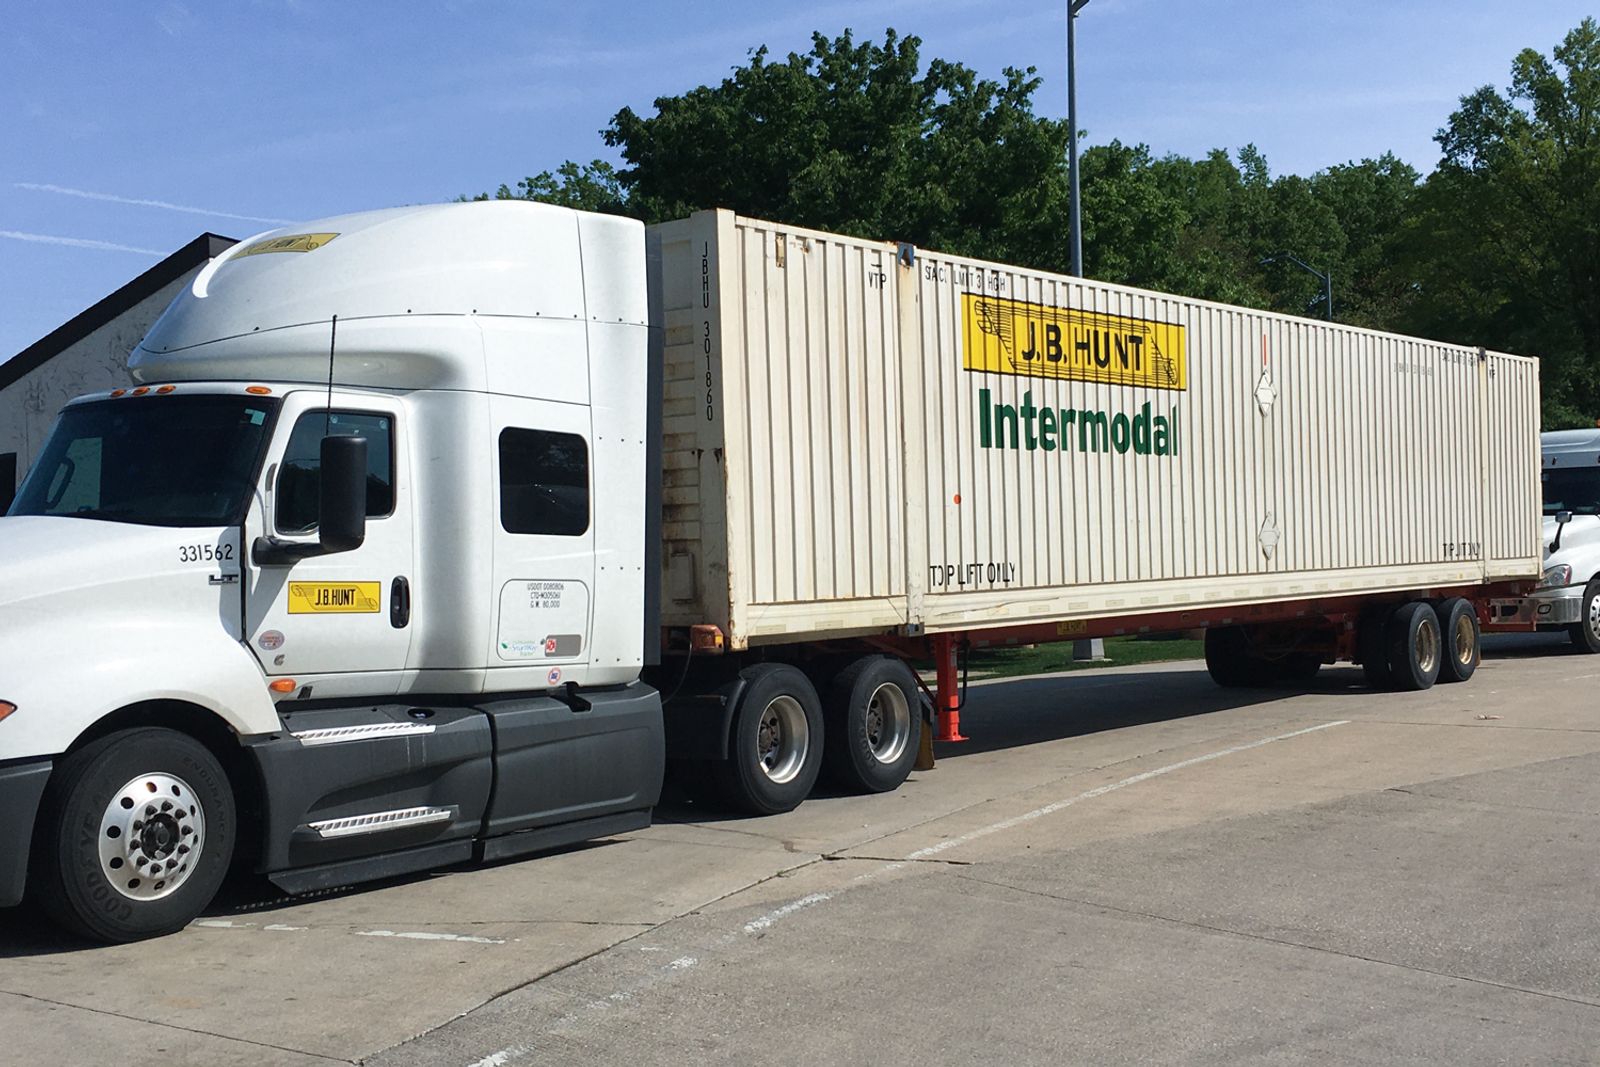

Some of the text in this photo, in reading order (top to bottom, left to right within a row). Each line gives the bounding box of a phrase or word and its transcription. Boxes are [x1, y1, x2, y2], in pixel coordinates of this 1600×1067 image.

[704, 321, 713, 421] 301860
[979, 388, 1178, 457] Intermodal
[179, 544, 234, 562] 331562
